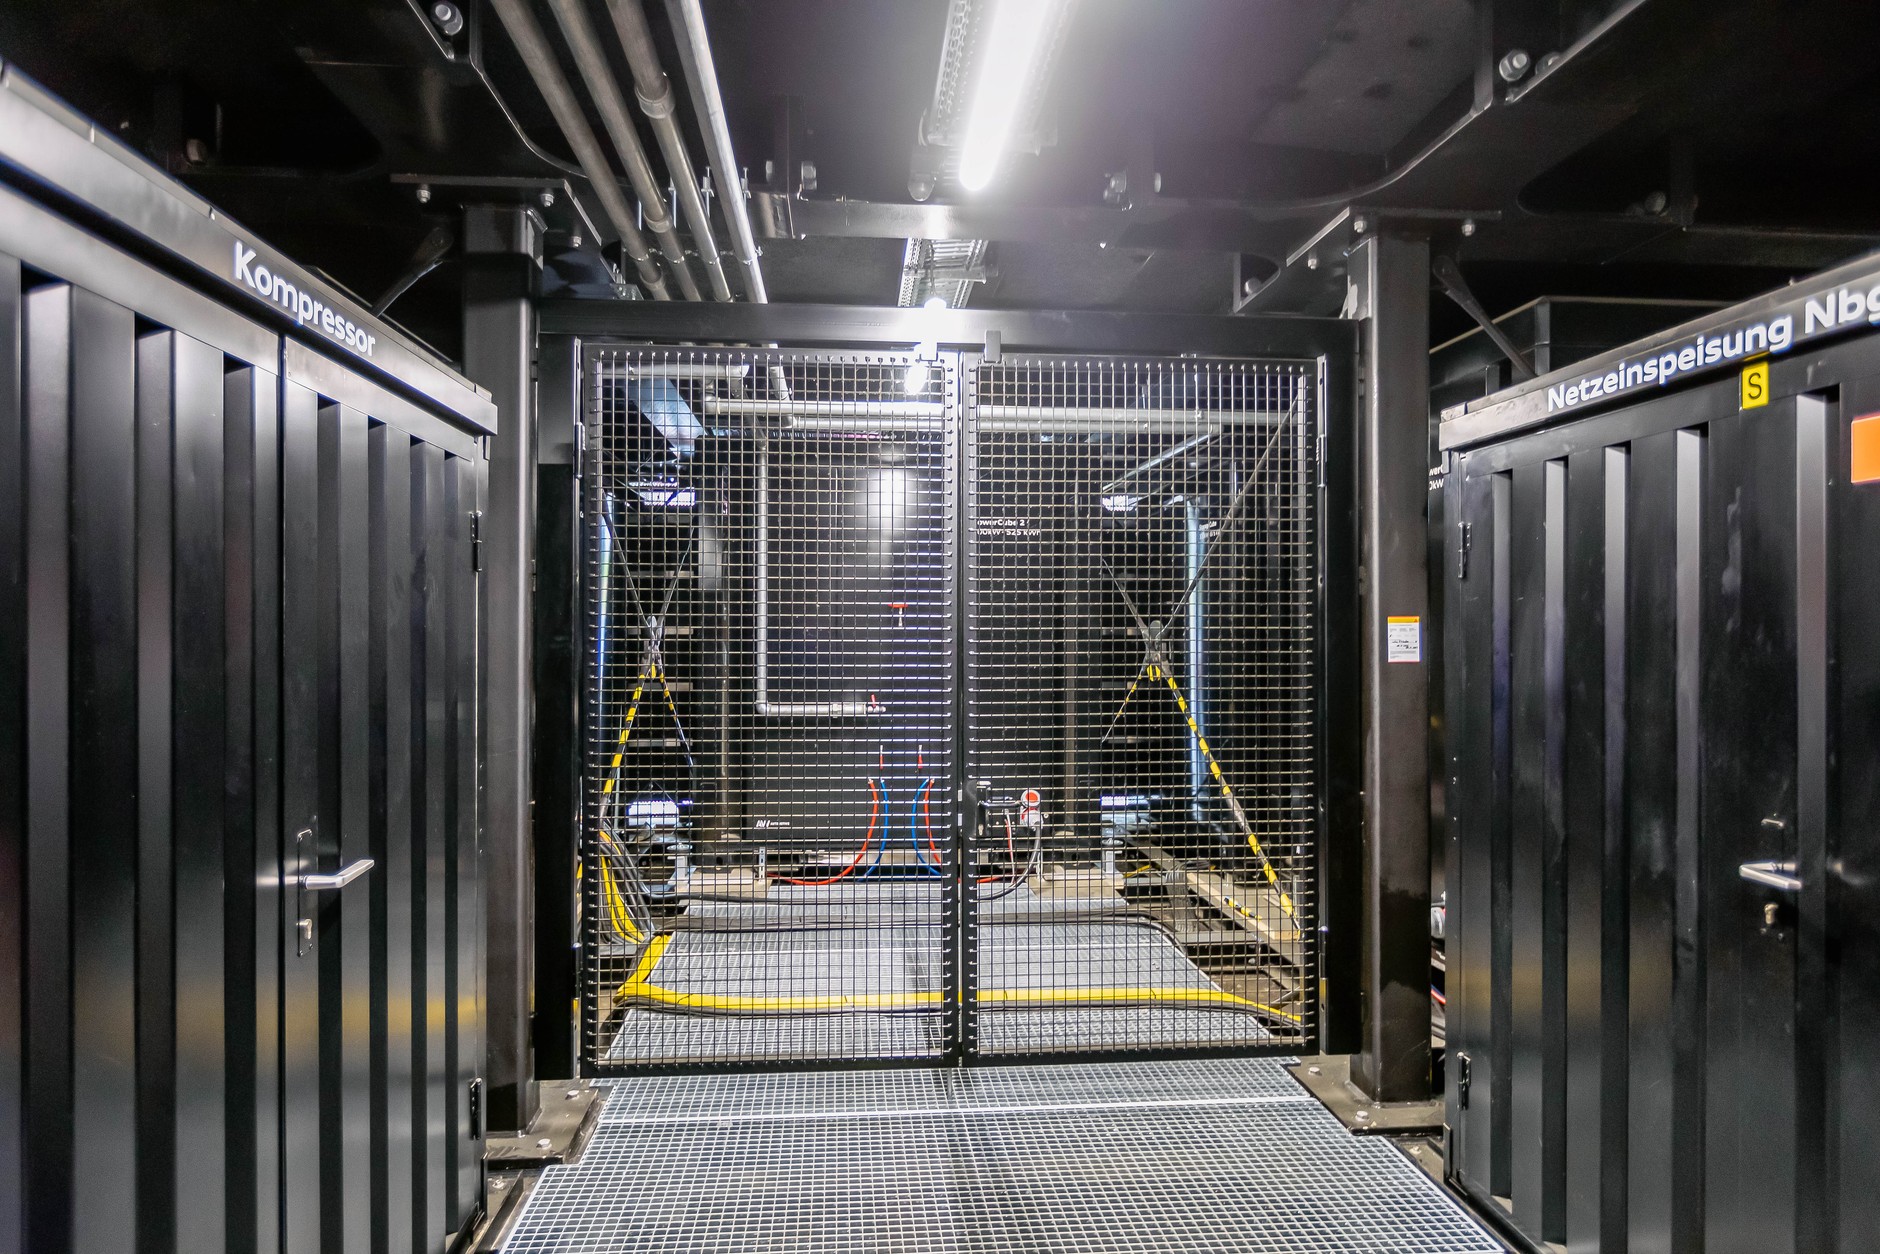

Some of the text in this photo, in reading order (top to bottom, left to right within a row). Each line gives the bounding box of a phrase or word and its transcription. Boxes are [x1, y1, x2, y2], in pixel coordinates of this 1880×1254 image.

[234, 241, 376, 357] Kompressor
[1547, 315, 1792, 412] Netzeinspeisung
[1748, 372, 1762, 400] S
